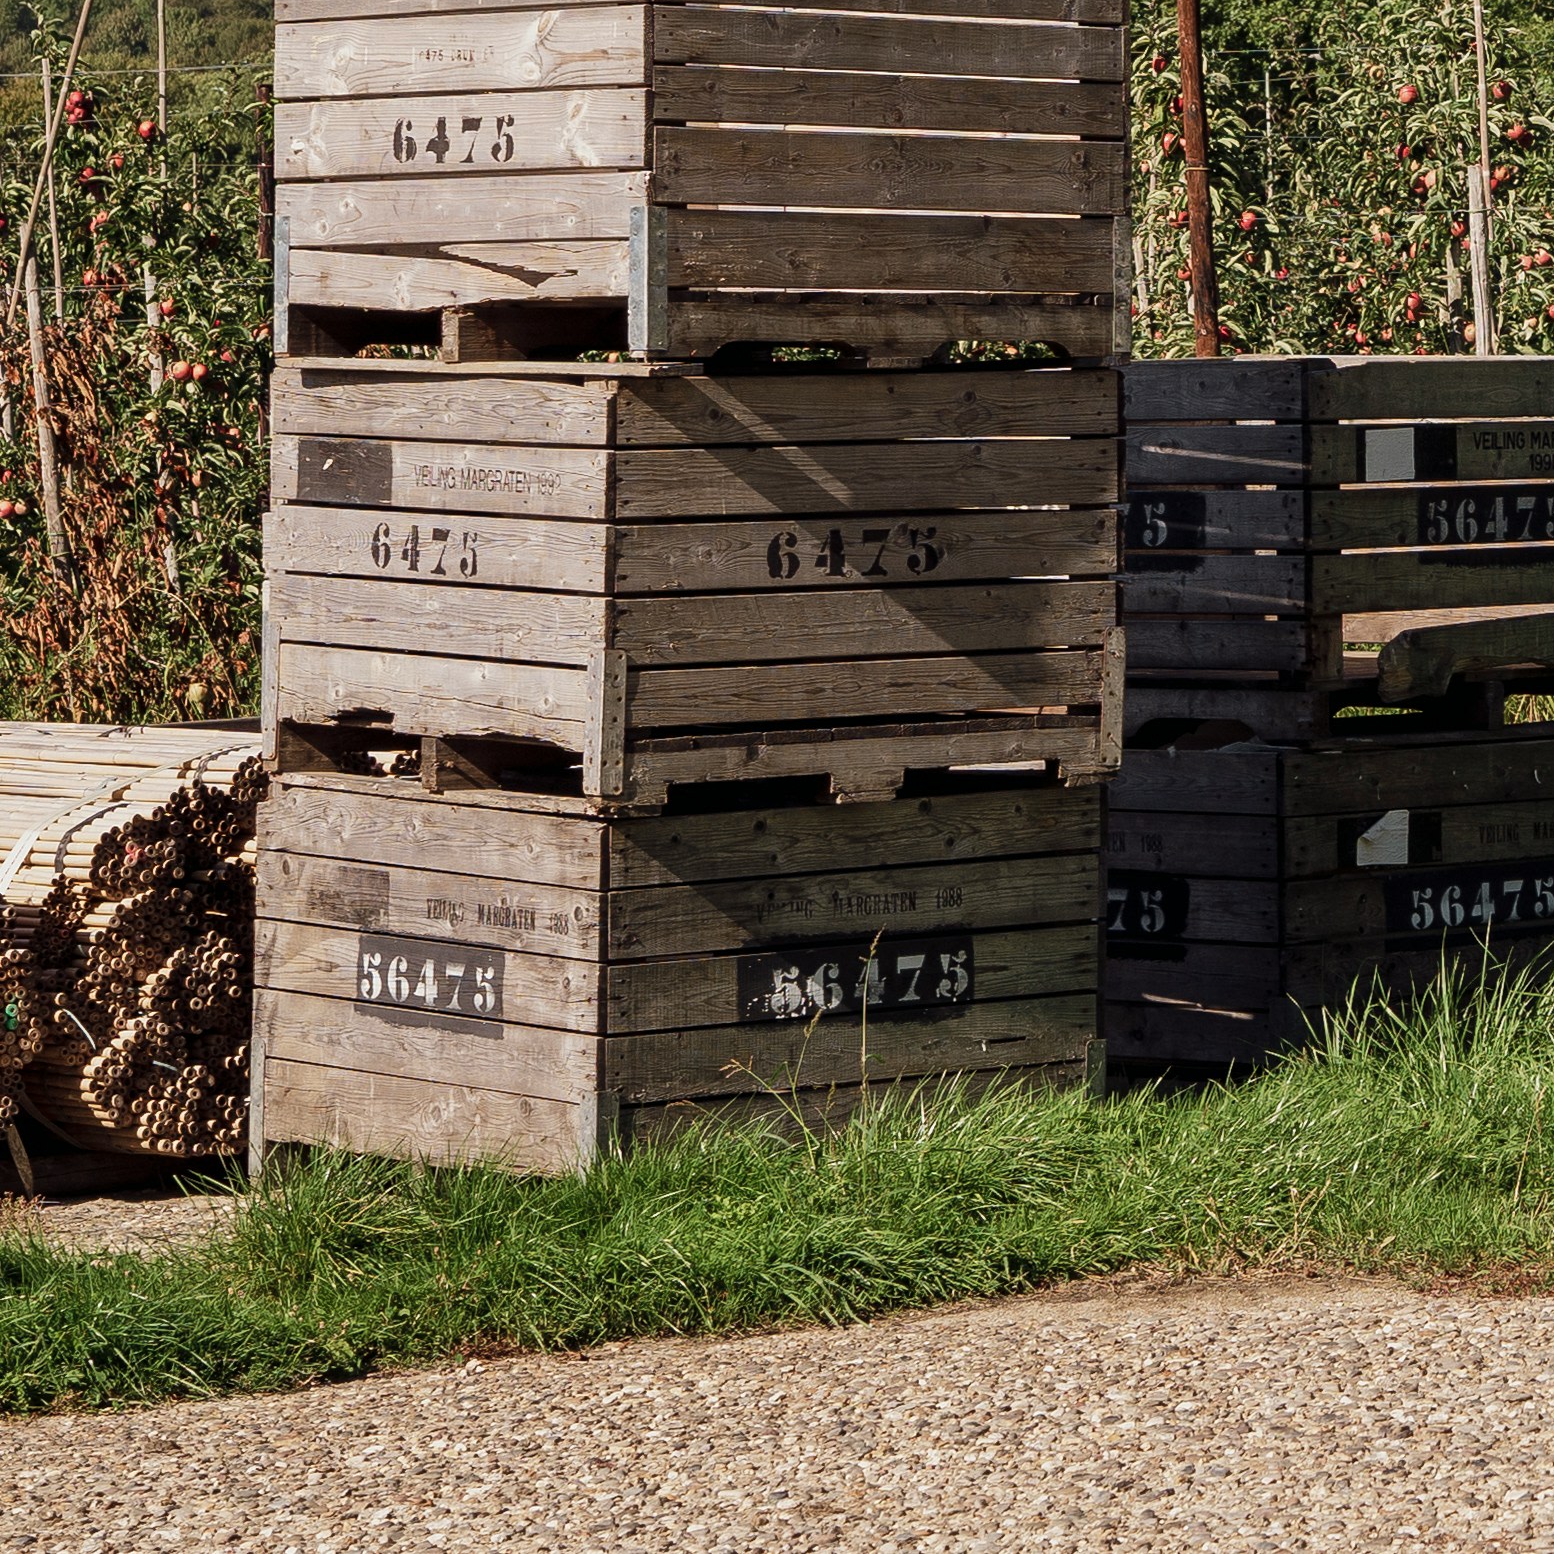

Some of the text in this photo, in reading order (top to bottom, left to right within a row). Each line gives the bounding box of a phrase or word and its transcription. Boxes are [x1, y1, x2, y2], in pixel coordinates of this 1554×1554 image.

[393, 114, 515, 164] 6475
[1473, 432, 1525, 451] VEILING
[461, 467, 532, 494] MARGRATEN
[371, 522, 478, 579] 6475
[766, 526, 939, 579] 6475
[477, 903, 536, 930] MARGRATEN
[360, 952, 496, 1013] 56475
[771, 949, 969, 1014] 56475
